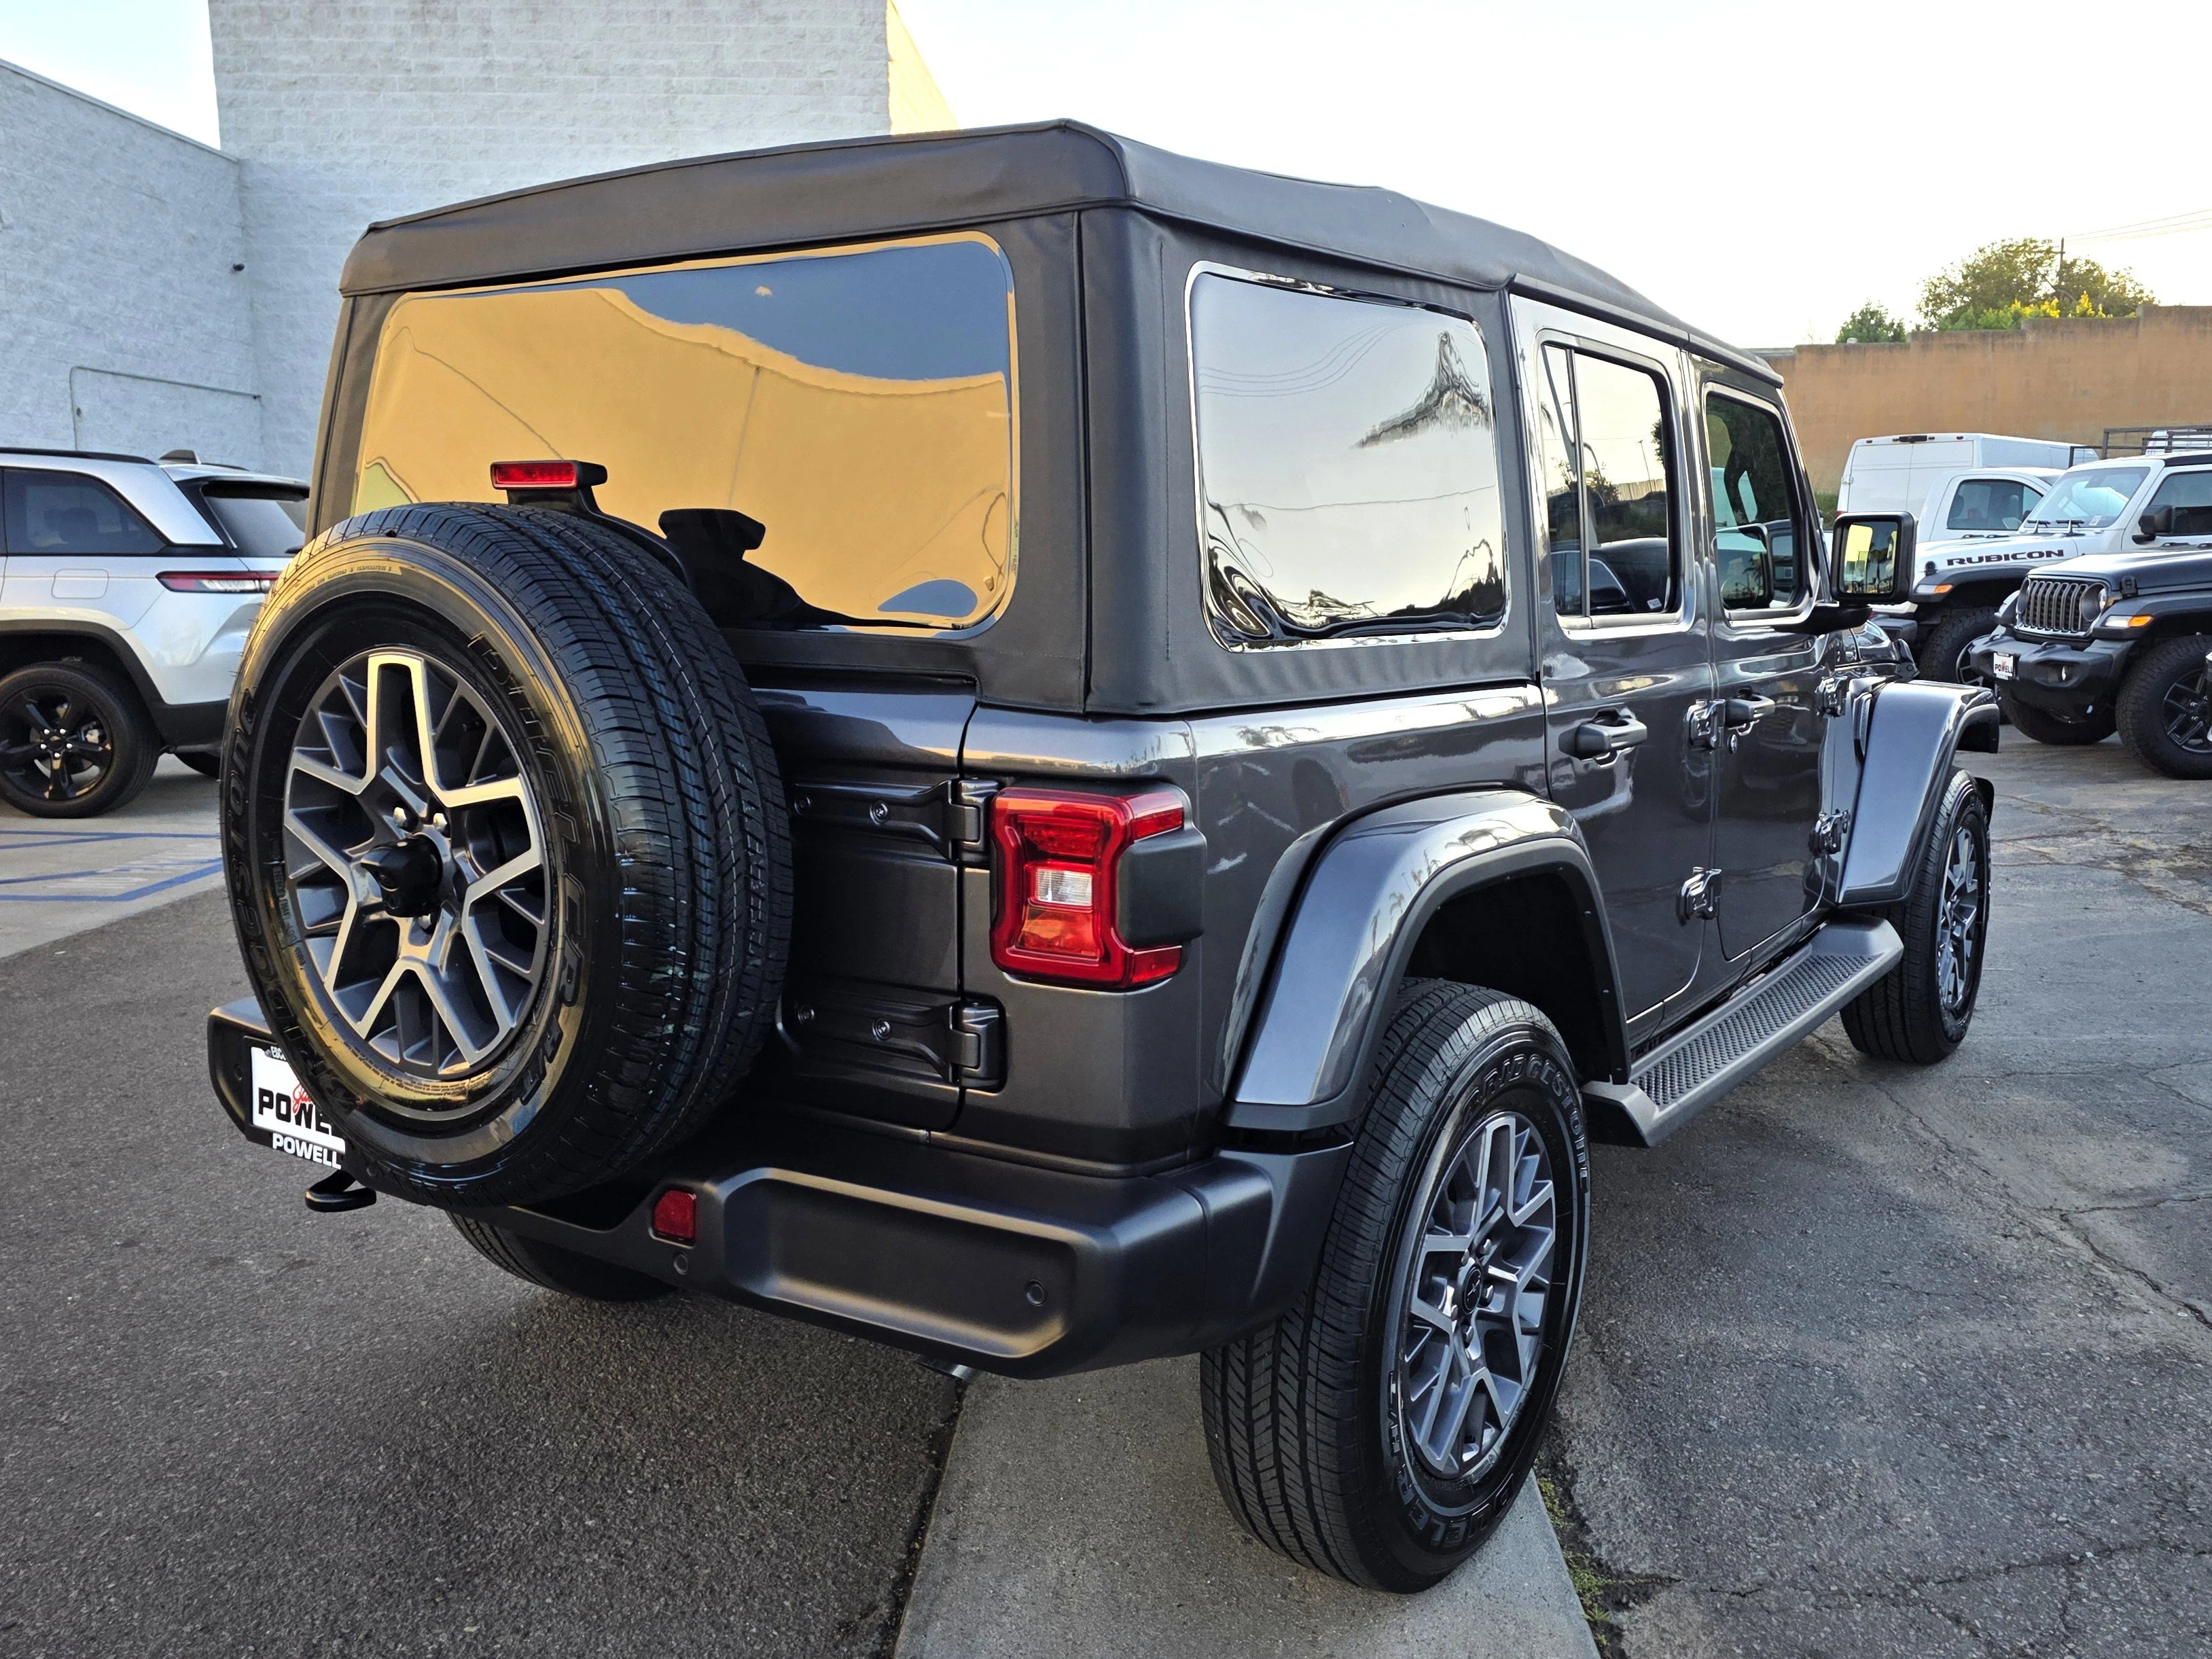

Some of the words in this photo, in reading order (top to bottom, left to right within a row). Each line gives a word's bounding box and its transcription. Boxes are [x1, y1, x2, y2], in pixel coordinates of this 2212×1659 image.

[1947, 550, 2063, 566] RUBICON
[258, 1087, 331, 1137] POWE
[1462, 1054, 1590, 1192] BRIDGESTONE
[272, 1132, 342, 1170] POWELL
